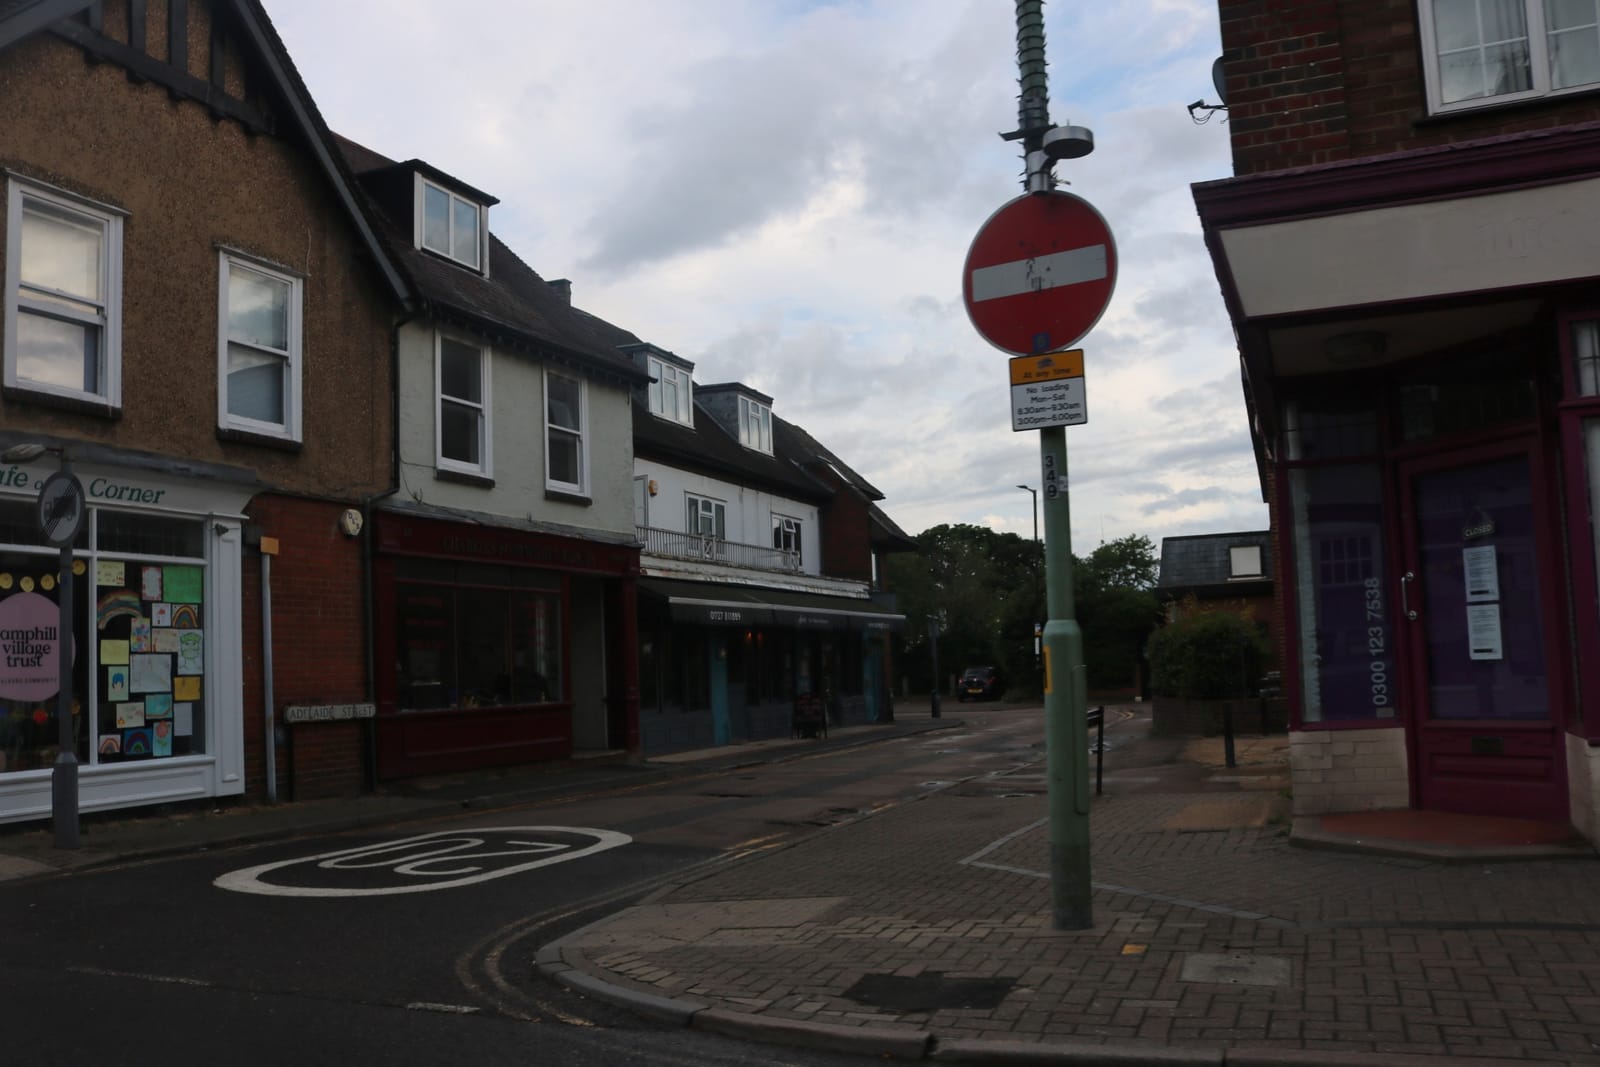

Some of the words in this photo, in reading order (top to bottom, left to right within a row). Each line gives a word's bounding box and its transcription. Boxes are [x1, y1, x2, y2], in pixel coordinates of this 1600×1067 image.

[1042, 383, 1070, 393] loading
[90, 478, 165, 504] Corner
[1464, 524, 1492, 537] CLOSED
[1364, 577, 1382, 622] 7538
[0, 627, 57, 644] amphill
[1368, 625, 1385, 656] 123
[3, 640, 51, 657] village
[7, 655, 42, 667] trust
[1370, 660, 1388, 706] 0300
